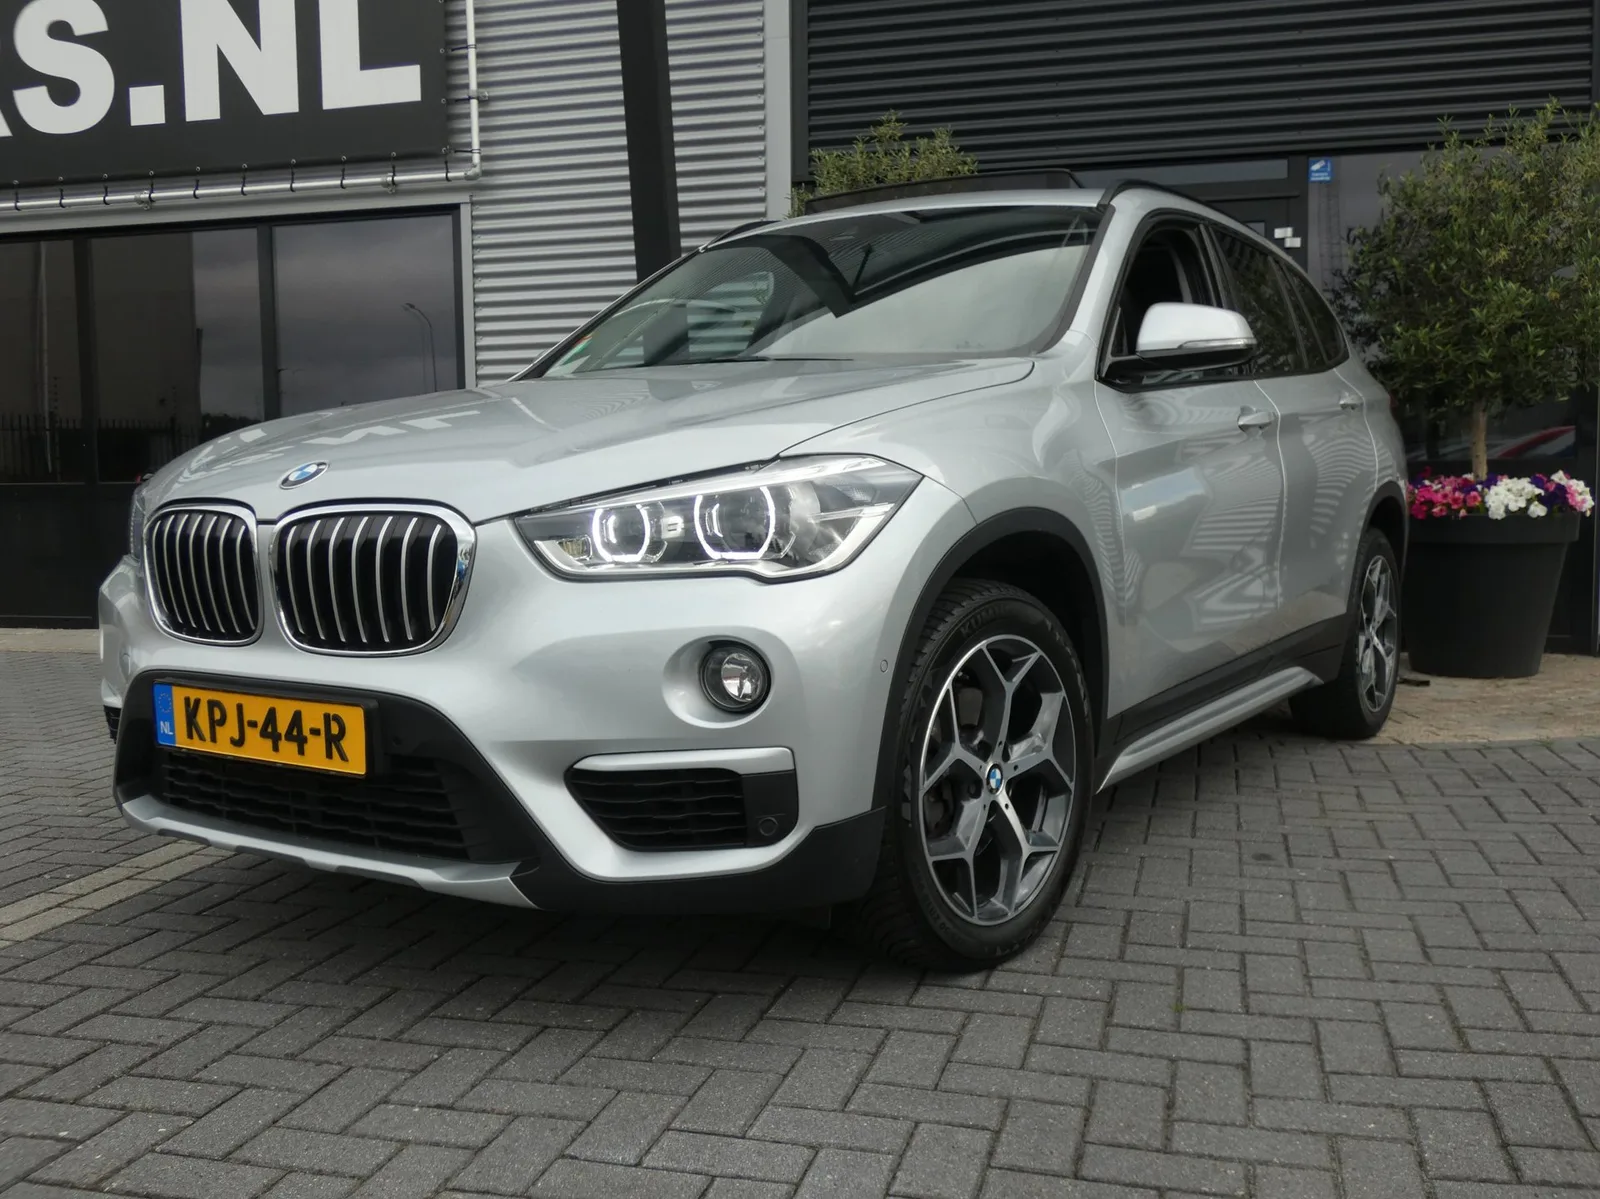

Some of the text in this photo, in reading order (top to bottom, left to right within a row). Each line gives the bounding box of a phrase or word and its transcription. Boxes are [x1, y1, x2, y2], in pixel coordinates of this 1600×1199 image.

[0, 0, 422, 137] S.NL
[160, 720, 174, 735] NL
[183, 695, 349, 763] KPJ-44-R
